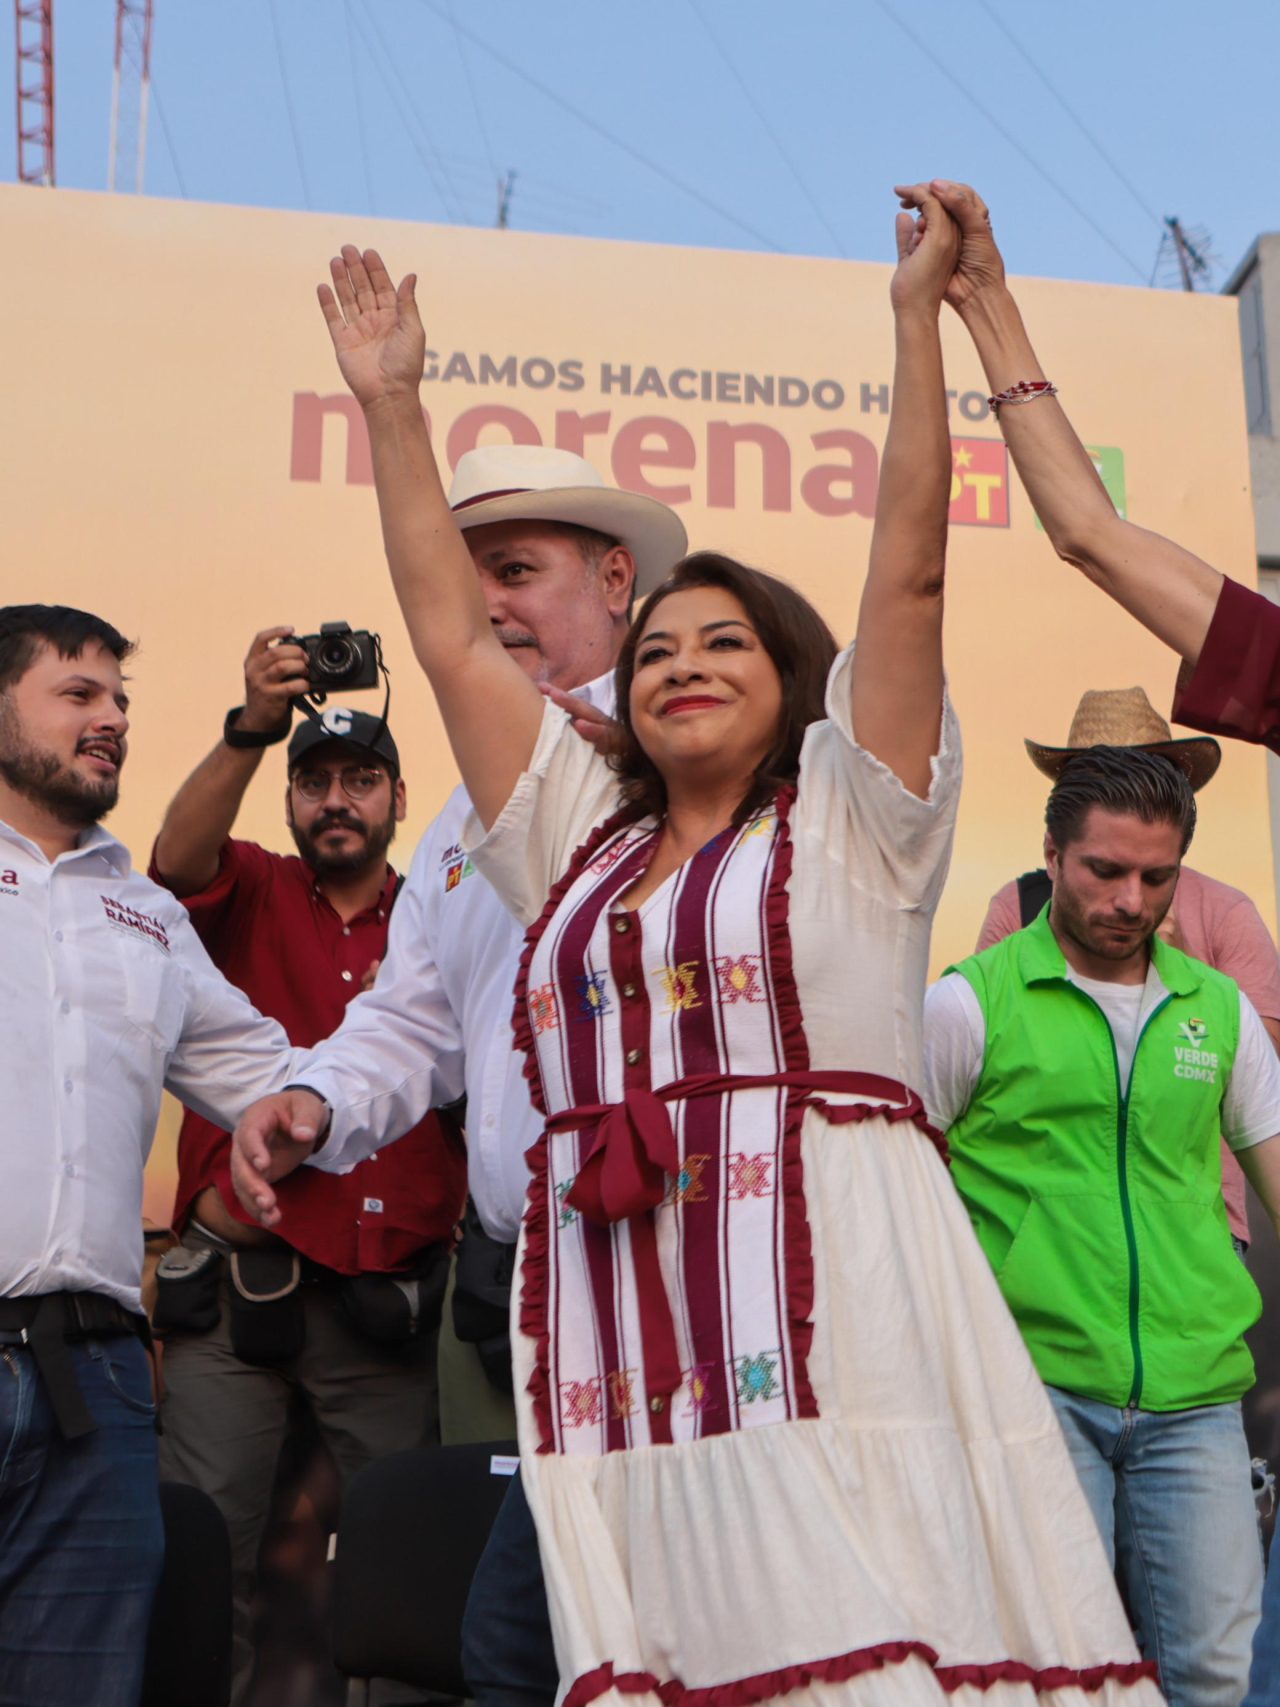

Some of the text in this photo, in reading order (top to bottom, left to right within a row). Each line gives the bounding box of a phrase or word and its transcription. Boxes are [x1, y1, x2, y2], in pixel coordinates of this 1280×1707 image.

[423, 348, 585, 392] GAMOS
[600, 362, 845, 411] HACIENDO
[104, 906, 171, 952] RAMÍREZ
[1173, 1064, 1216, 1084] CDMX
[1174, 1046, 1218, 1069] VERDE
